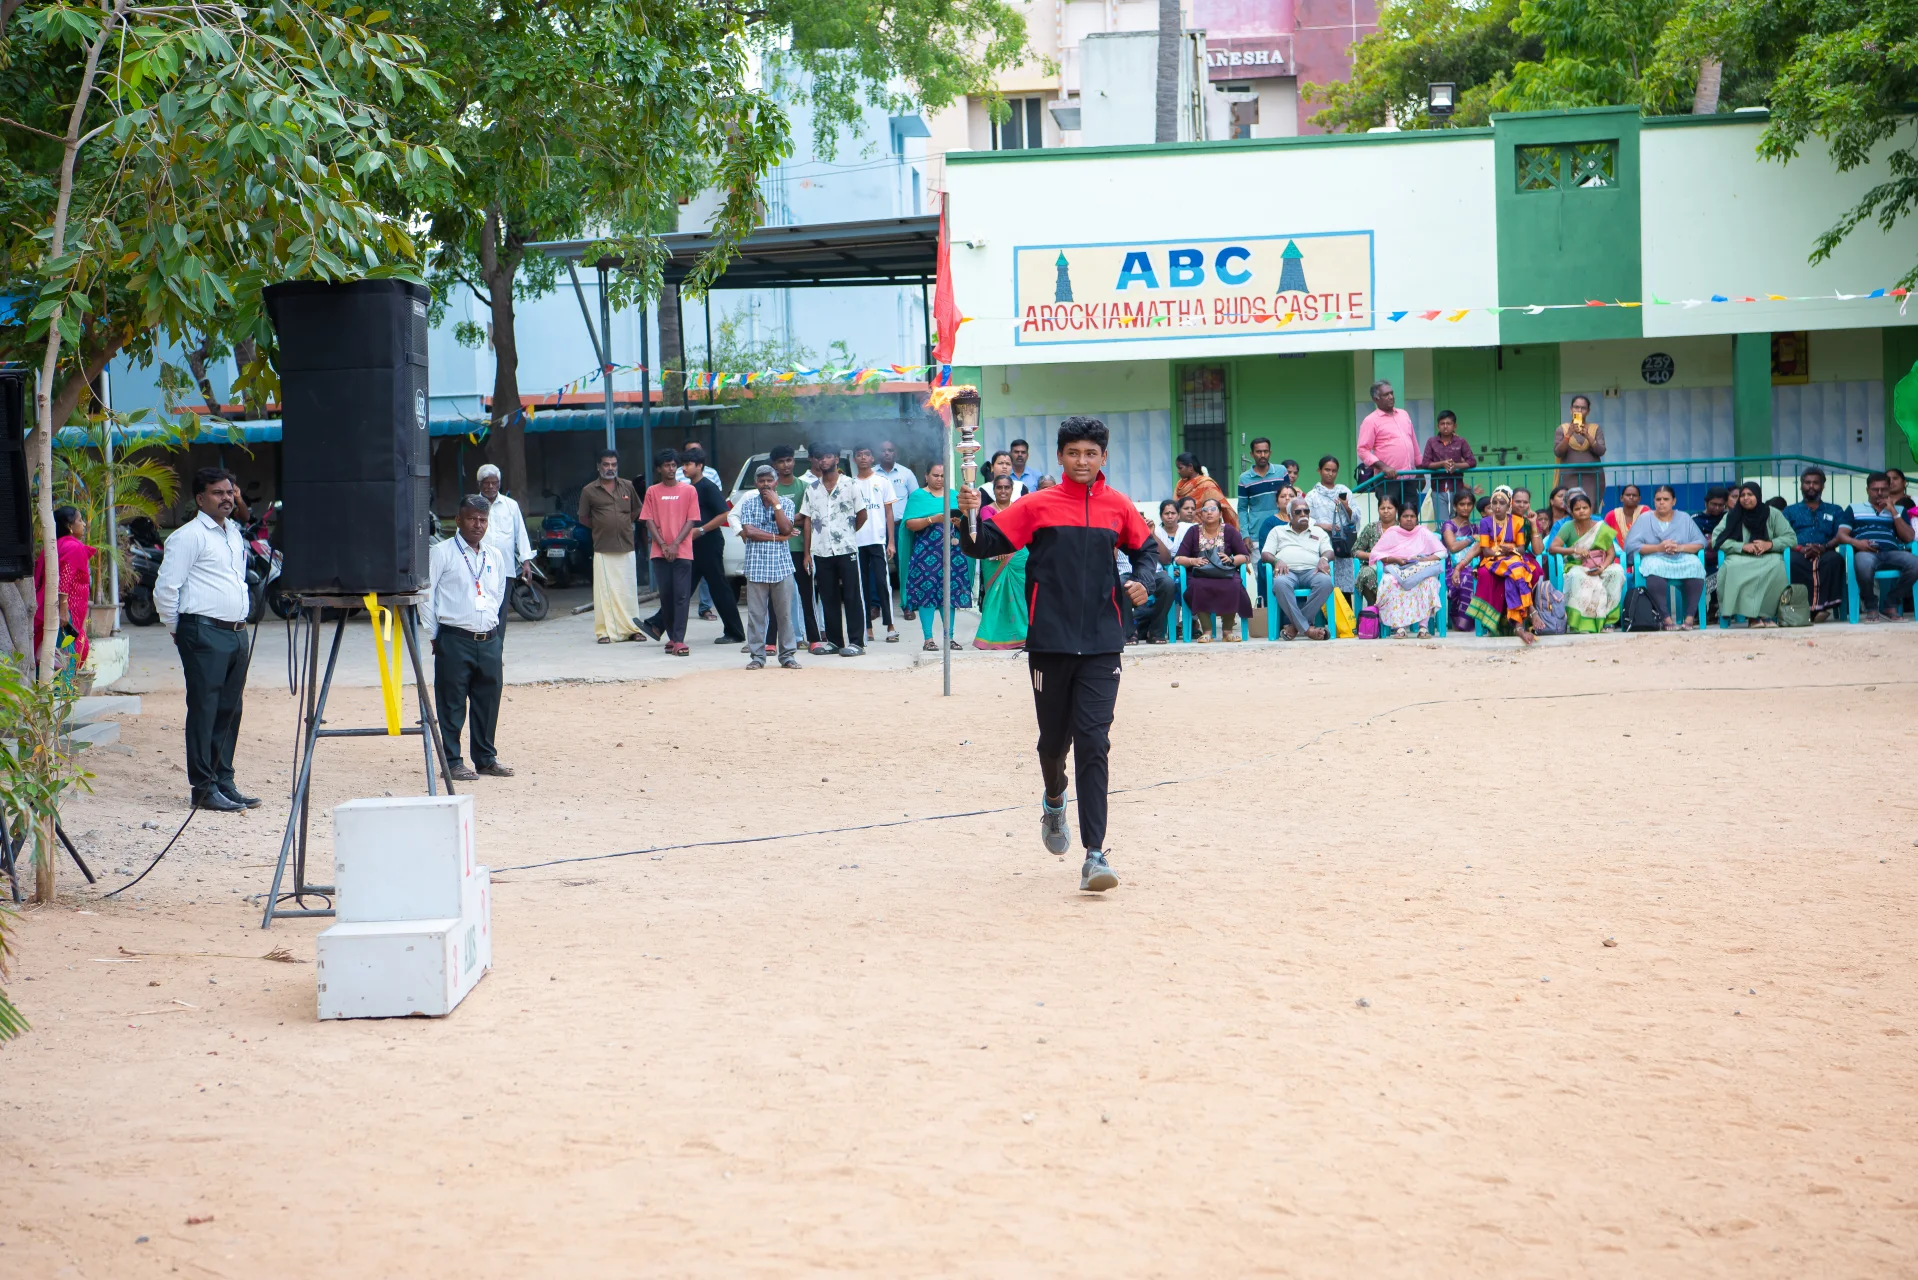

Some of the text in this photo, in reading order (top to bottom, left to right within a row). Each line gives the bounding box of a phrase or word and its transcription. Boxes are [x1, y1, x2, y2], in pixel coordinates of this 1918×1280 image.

[1206, 50, 1284, 67] ANESHA
[1116, 246, 1252, 290] ABC
[1023, 292, 1363, 332] AROCKIAMATHA BUDS CASTLE
[1646, 370, 1670, 383] 140
